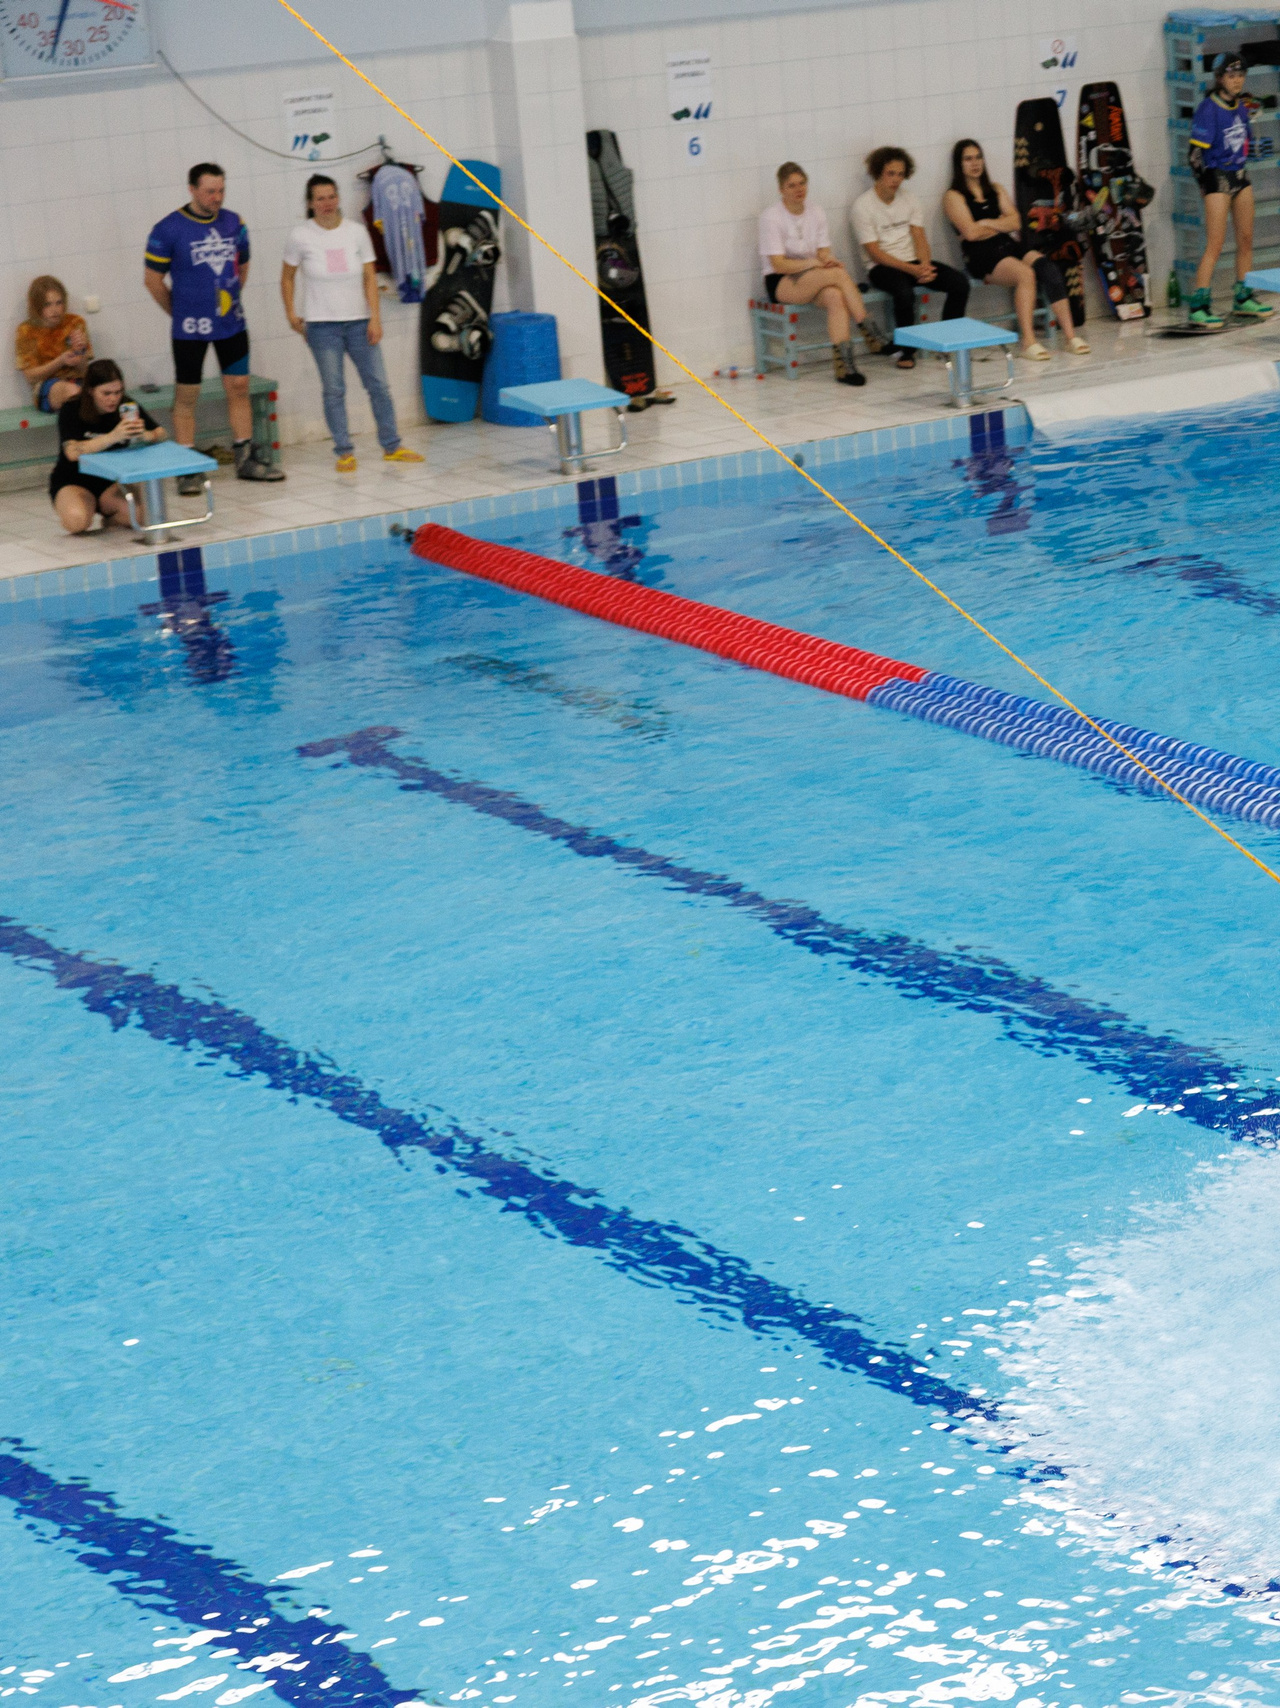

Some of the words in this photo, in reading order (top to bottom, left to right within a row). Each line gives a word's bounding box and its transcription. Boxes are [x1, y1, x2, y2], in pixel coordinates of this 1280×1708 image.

[17, 12, 39, 29] 40
[102, 4, 125, 21] 20
[87, 25, 110, 43] 25
[62, 39, 86, 57] 30
[1056, 89, 1067, 108] 7
[688, 136, 701, 156] 6
[182, 317, 213, 335] 68
